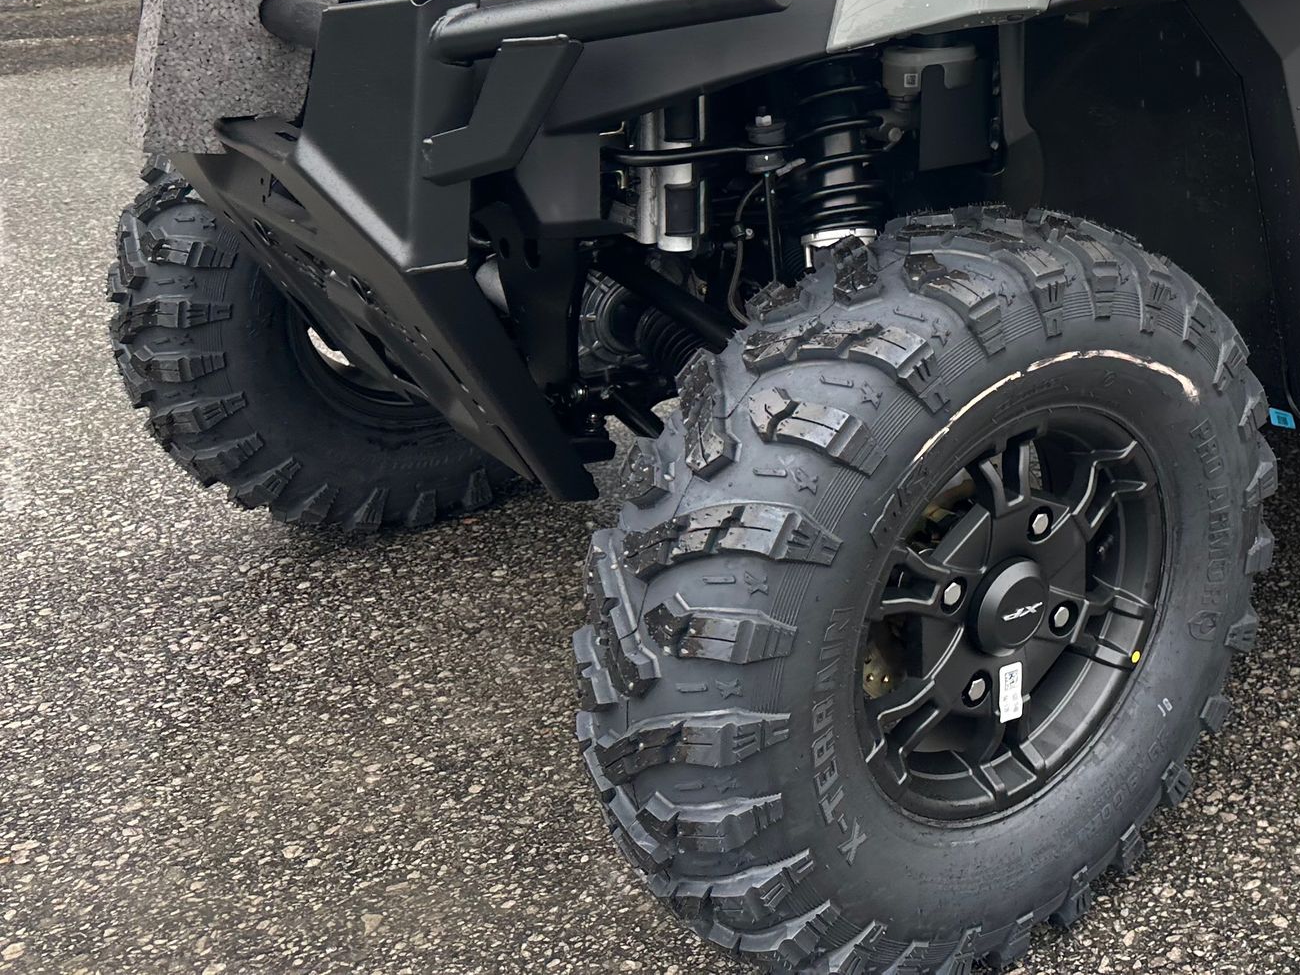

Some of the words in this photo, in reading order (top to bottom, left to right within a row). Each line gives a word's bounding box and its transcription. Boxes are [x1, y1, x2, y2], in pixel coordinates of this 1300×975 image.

[1190, 417, 1226, 480] PRO
[1203, 484, 1231, 606] ARMOR
[811, 608, 868, 866] X-TERRAIN
